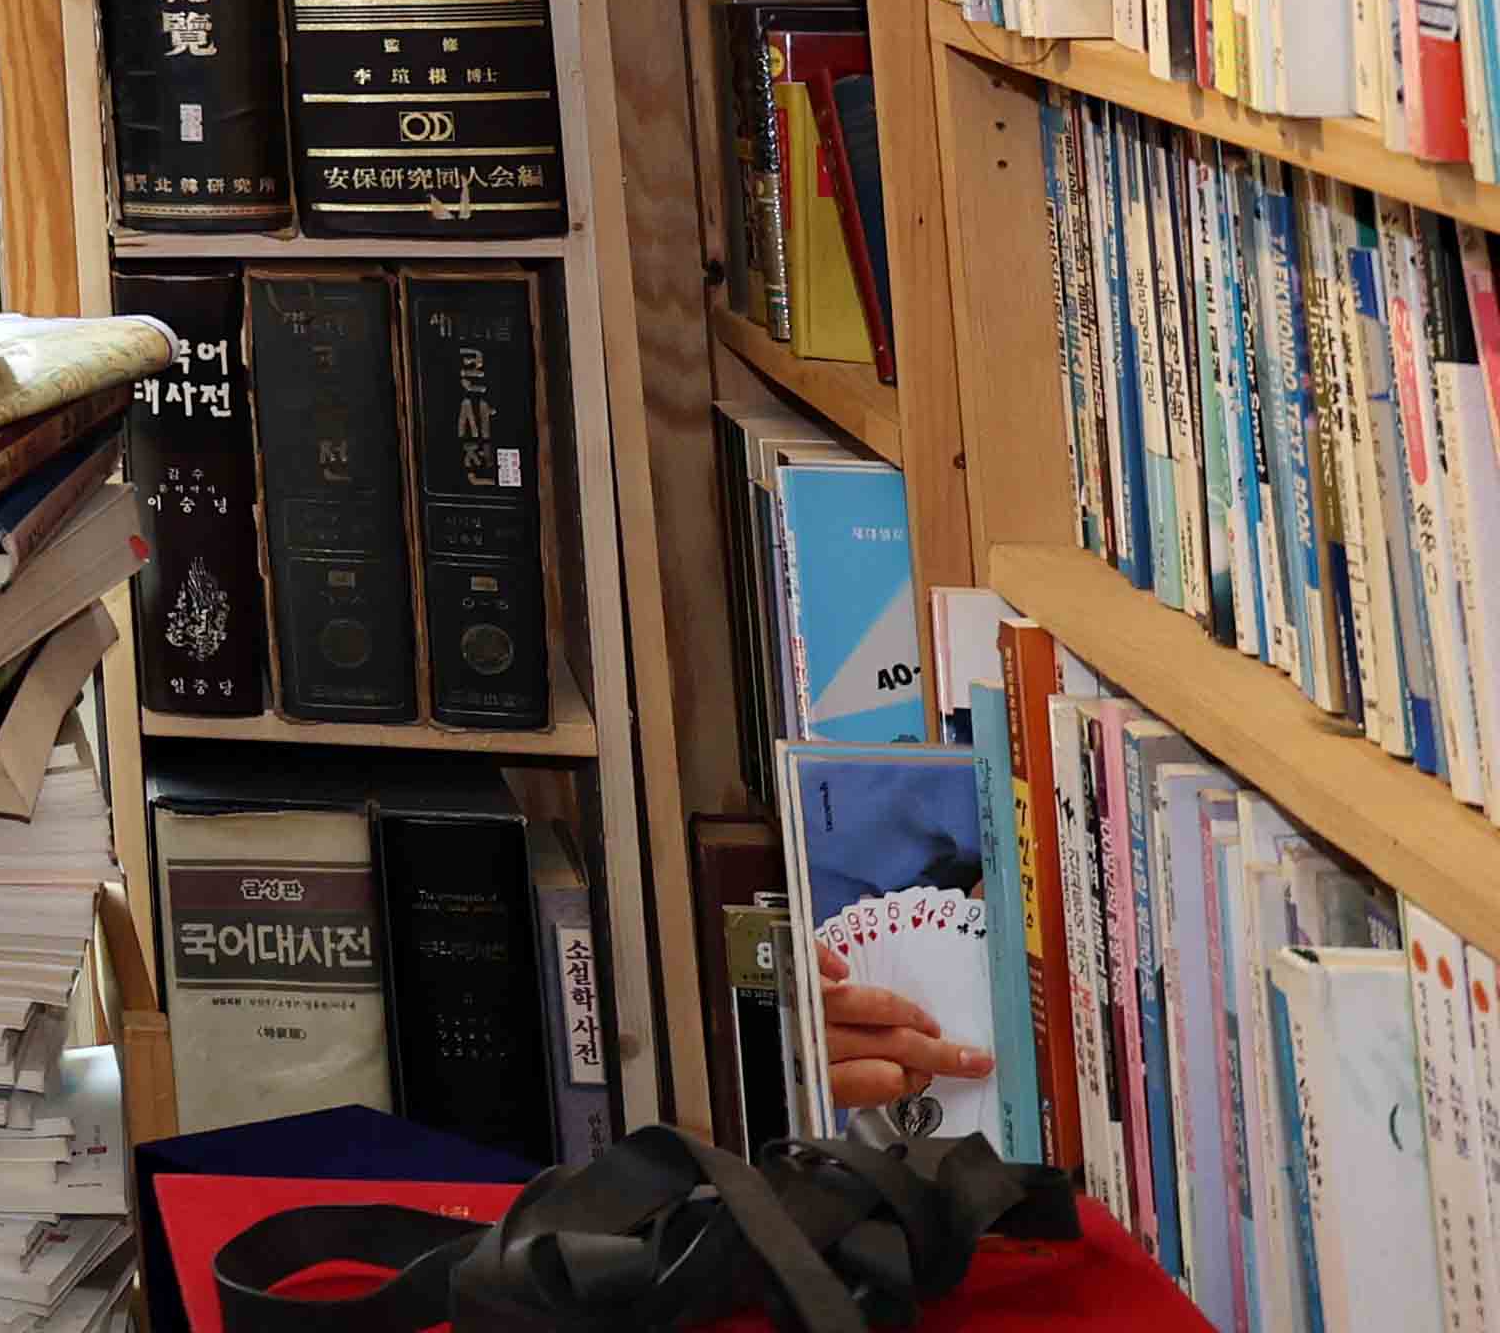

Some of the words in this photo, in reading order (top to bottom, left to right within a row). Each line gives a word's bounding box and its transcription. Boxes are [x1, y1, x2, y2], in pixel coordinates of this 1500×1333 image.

[1241, 309, 1257, 386] Color
[1269, 235, 1300, 393] TAEKWONDO
[1248, 393, 1268, 475] Smart
[240, 877, 305, 902] 금성판
[179, 922, 373, 968] 국어대사전
